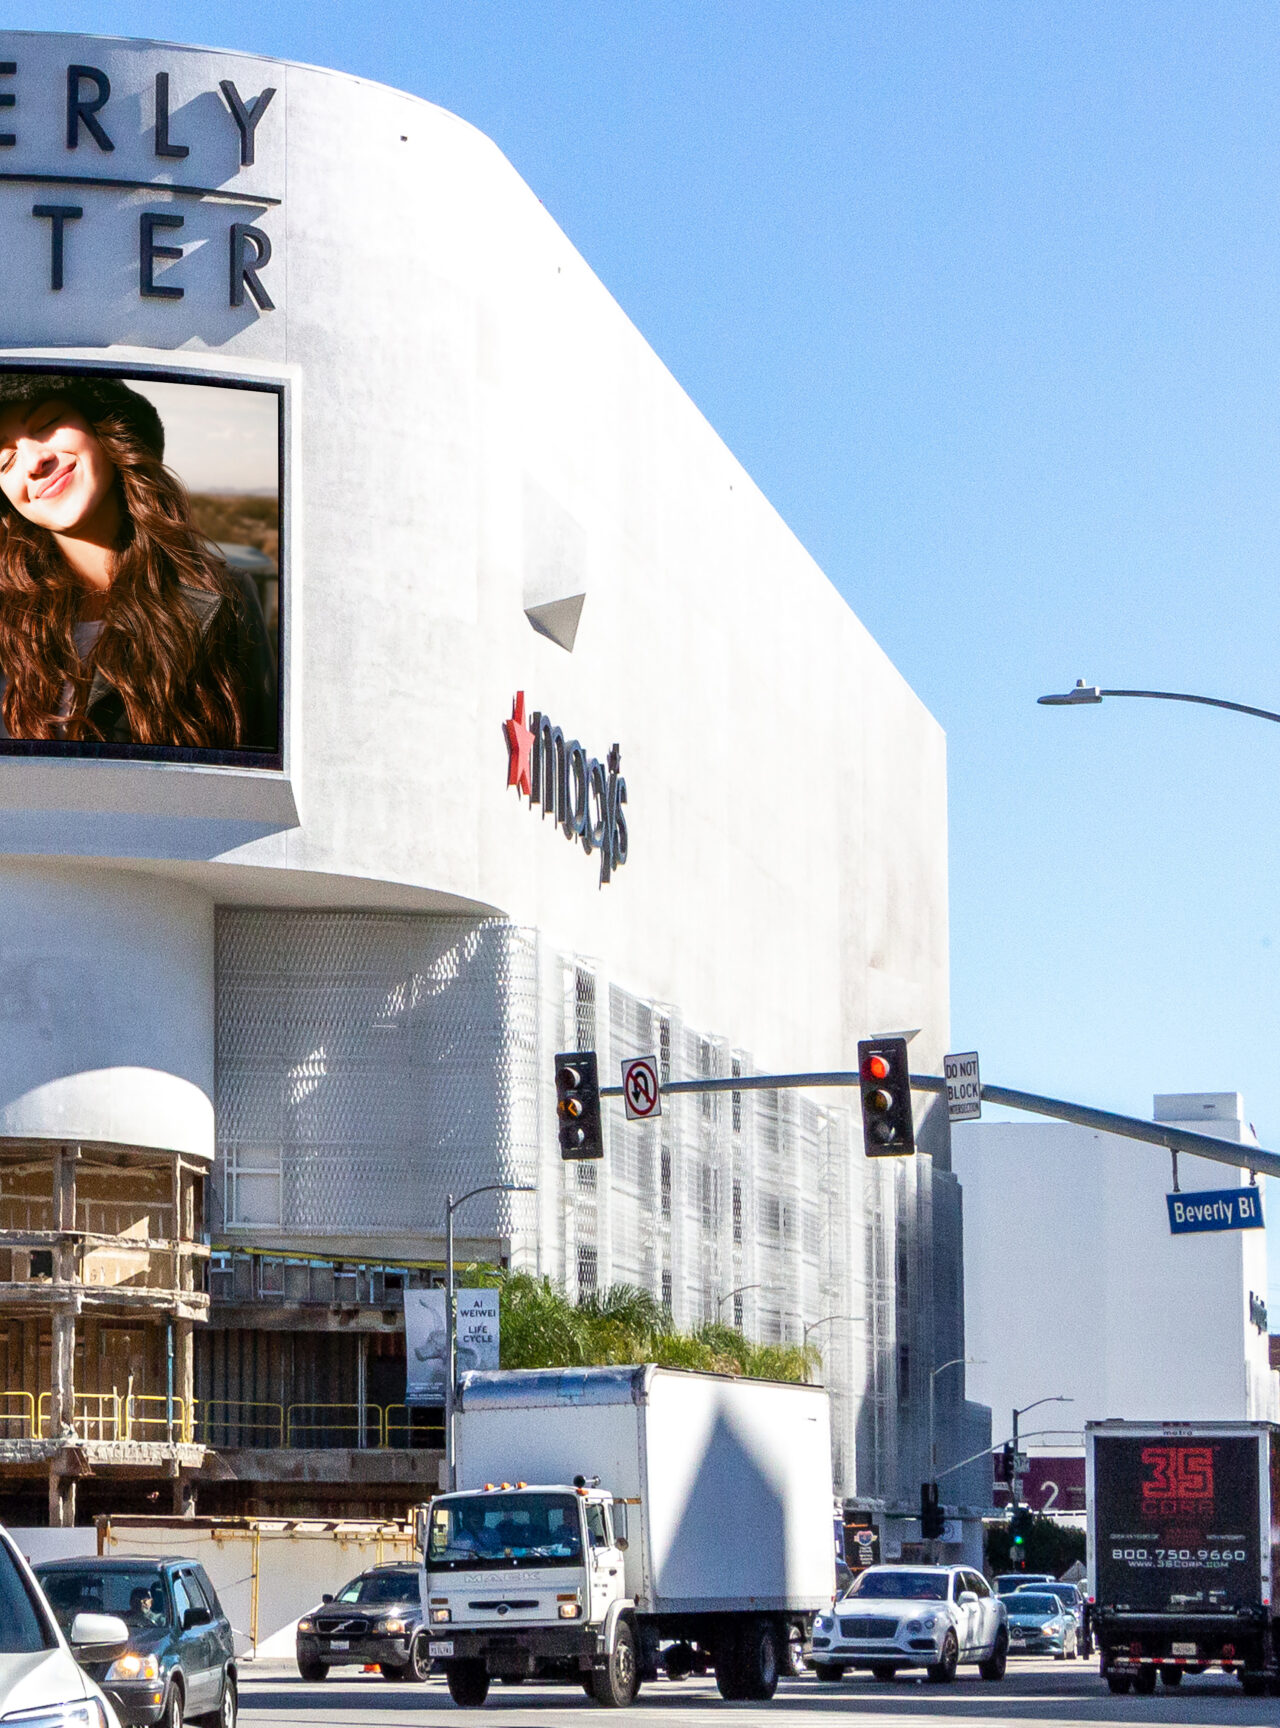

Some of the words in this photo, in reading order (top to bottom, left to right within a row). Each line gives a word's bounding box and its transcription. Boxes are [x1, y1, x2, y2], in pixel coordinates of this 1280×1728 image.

[946, 1063, 958, 1079] DO
[960, 1060, 977, 1077] NOT
[947, 1083, 979, 1100] BLOCK
[1174, 1199, 1234, 1224] Beverly
[1238, 1196, 1256, 1218] Bl
[473, 1300, 483, 1308] AI
[460, 1309, 496, 1318] WEIWEI
[468, 1325, 488, 1334] LIFE
[462, 1335, 493, 1343] CYCLE
[1040, 1480, 1059, 1511] 2
[1112, 1549, 1246, 1561] 800.750.9660
[463, 1571, 541, 1583] MACK
